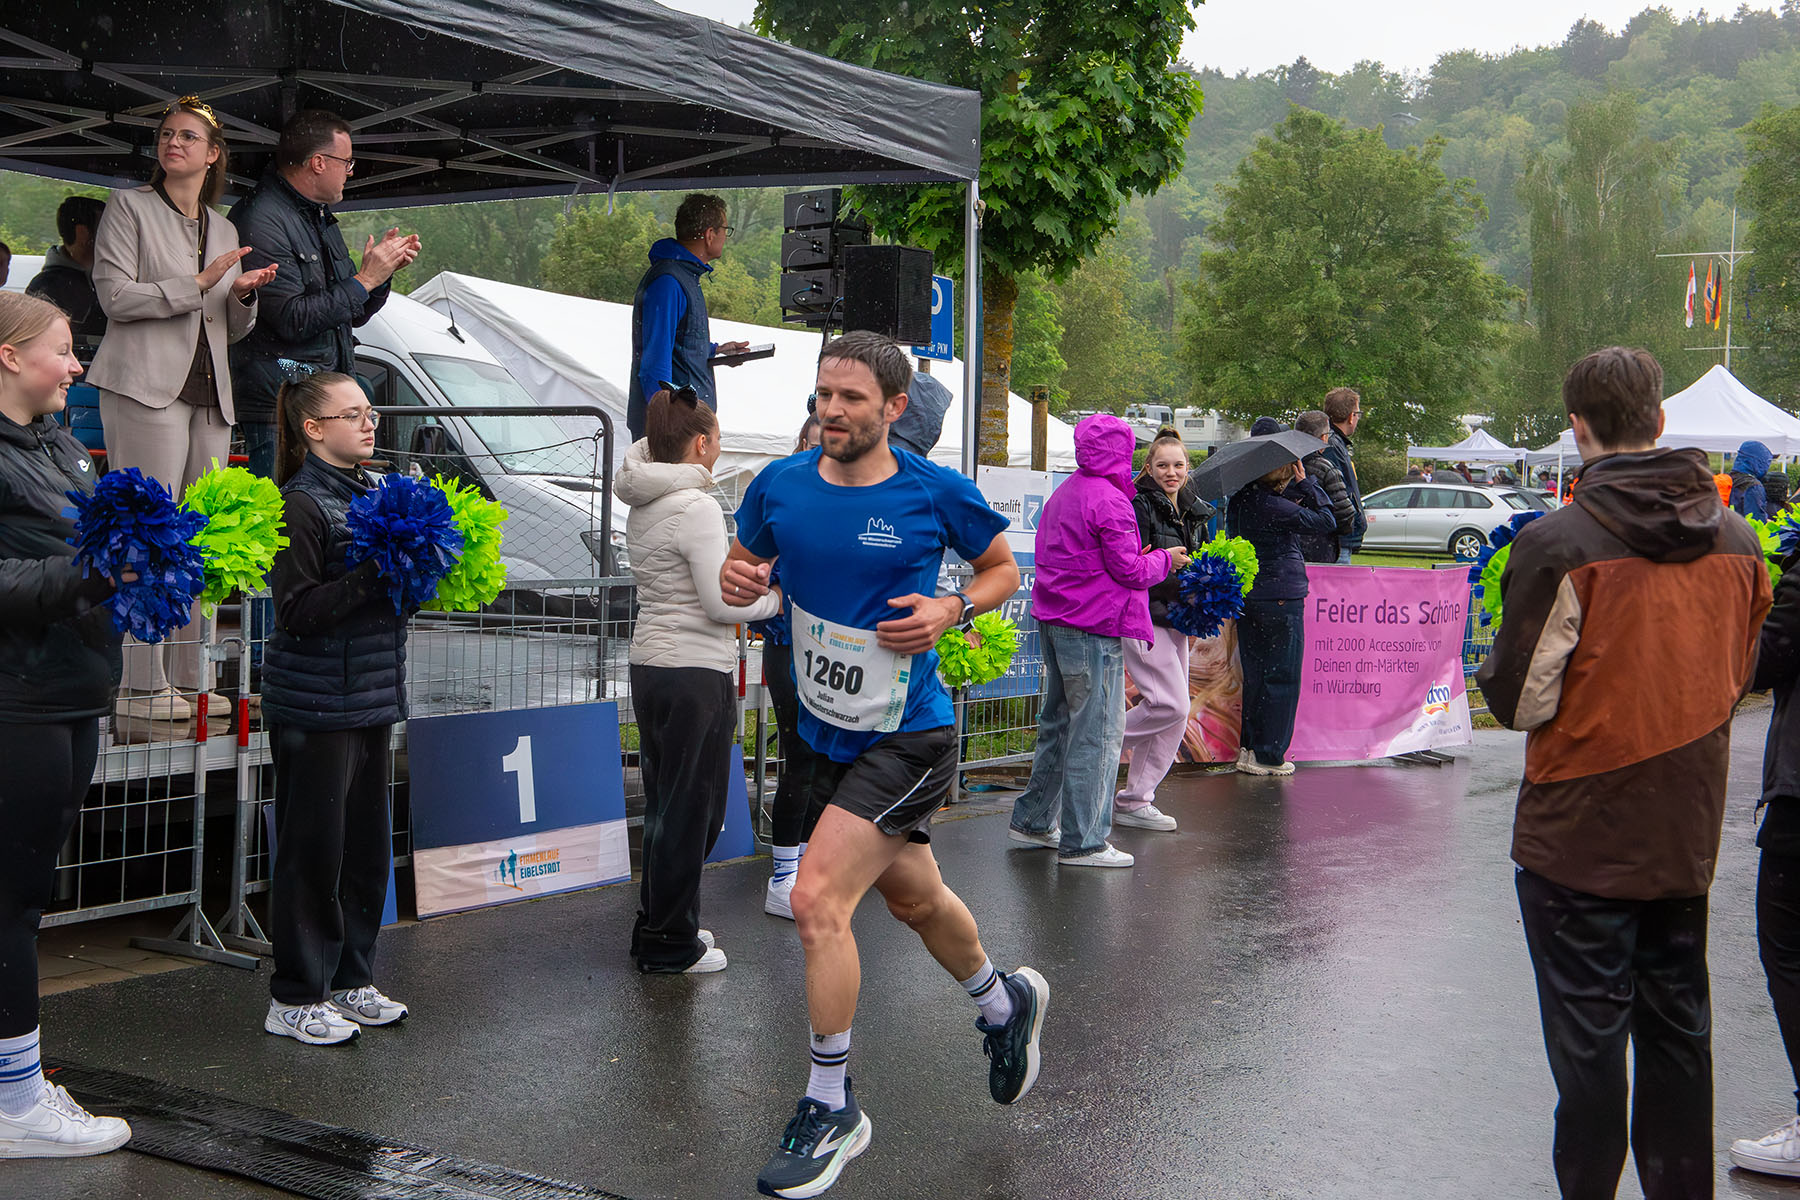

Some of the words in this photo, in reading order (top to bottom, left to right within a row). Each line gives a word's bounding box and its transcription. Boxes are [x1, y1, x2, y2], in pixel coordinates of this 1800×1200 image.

[993, 499, 1021, 513] manlift
[1316, 598, 1369, 623] Feier
[1375, 599, 1410, 624] das
[1418, 600, 1461, 625] Schöne
[1315, 637, 1334, 651] mit
[1337, 638, 1365, 651] 2000
[1369, 638, 1426, 652] Accessoires
[1428, 640, 1441, 651] von
[804, 649, 864, 695] 1260
[1314, 658, 1351, 673] Deinen
[1355, 658, 1420, 673] dm-Märkten
[817, 690, 835, 704] Julian
[1313, 679, 1323, 694] in
[1327, 679, 1382, 697] Würzburg
[1426, 680, 1450, 705] dm
[502, 735, 537, 824] 1
[519, 848, 560, 866] FIRMENLAUF
[520, 861, 561, 879] EIBELSTADT
